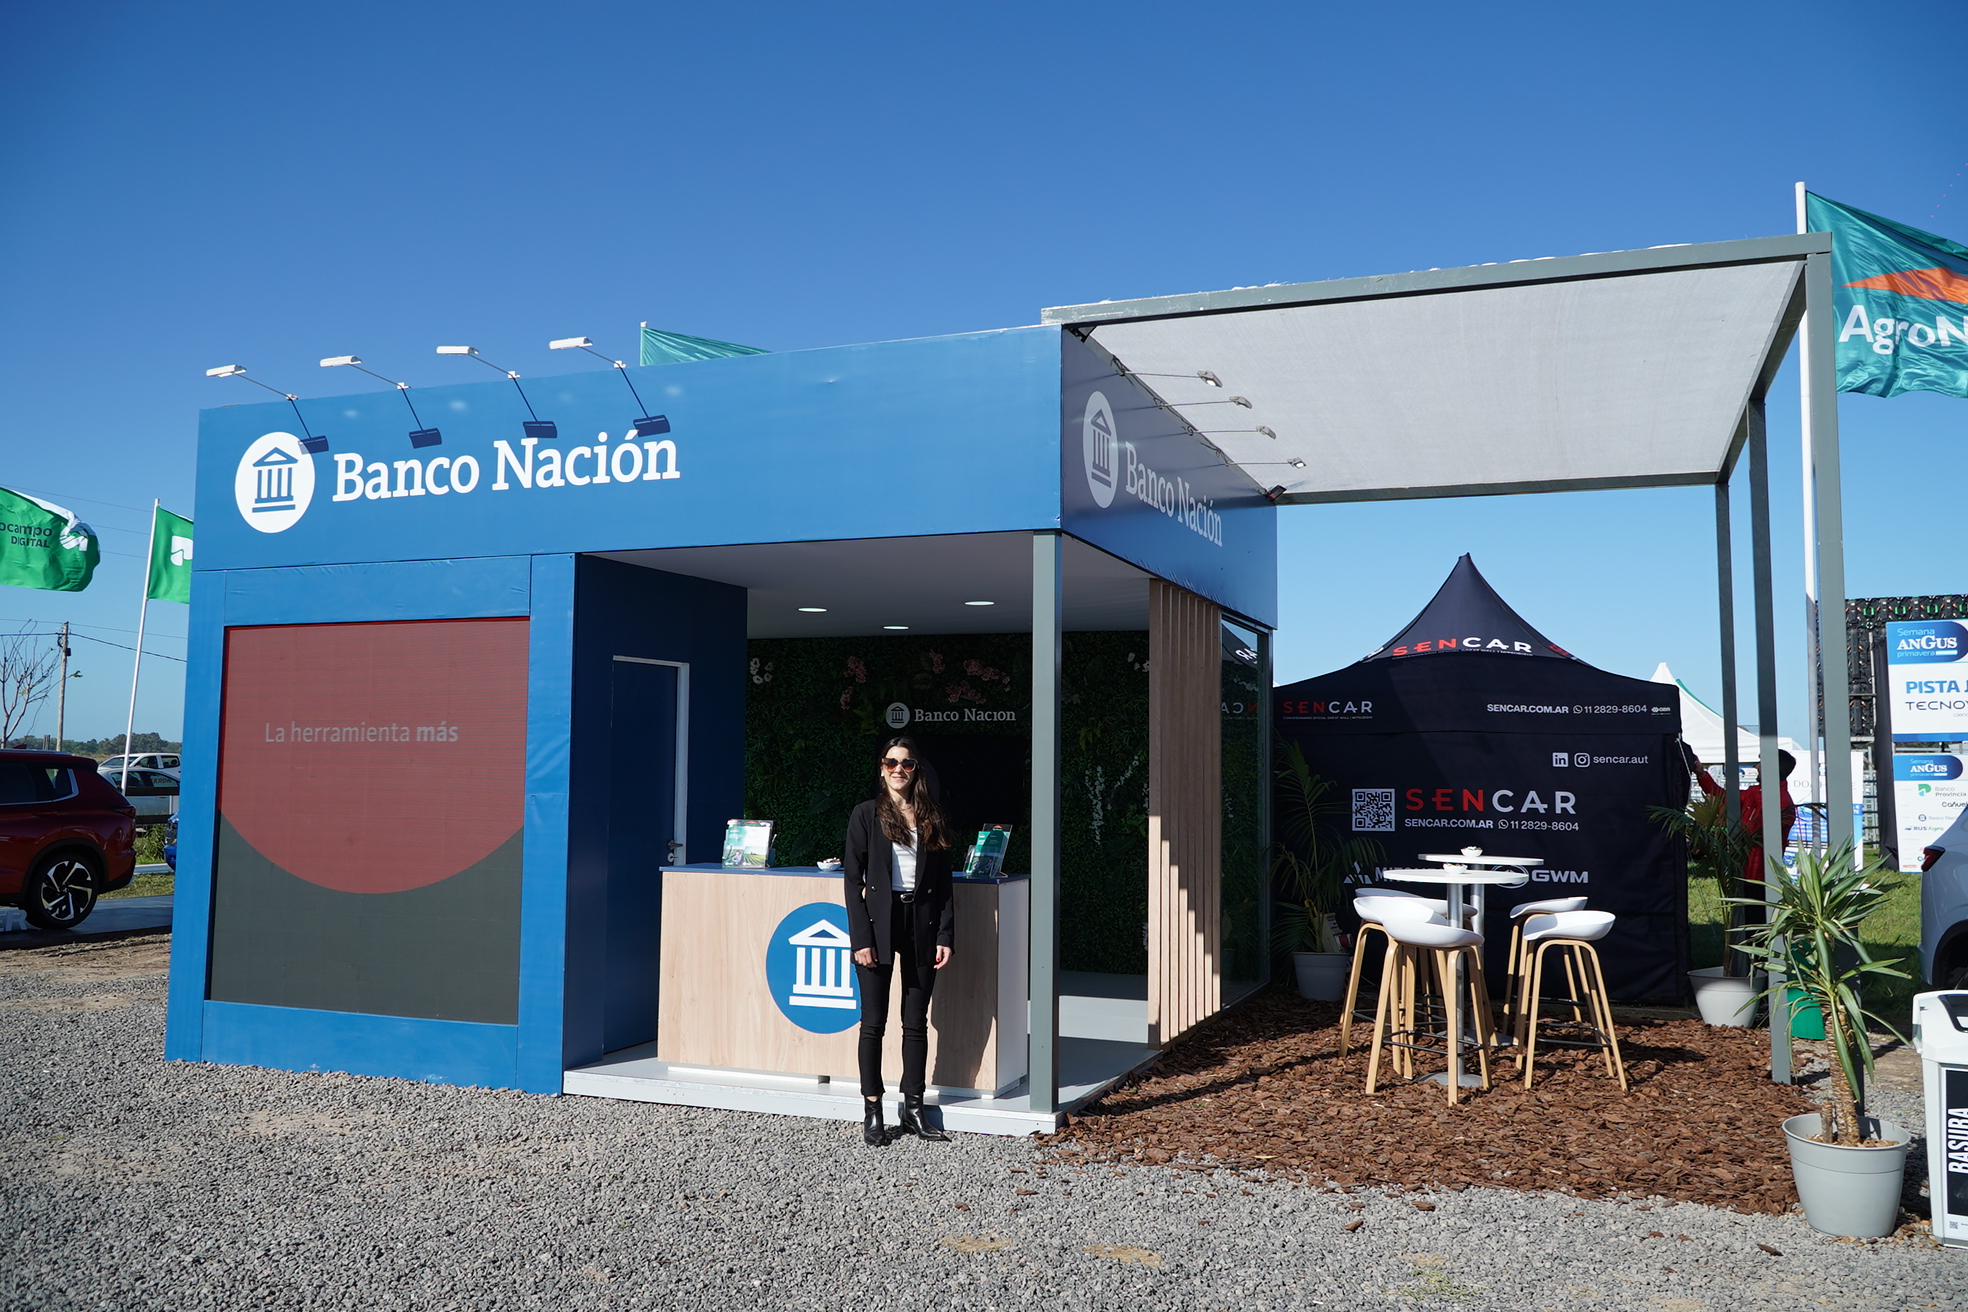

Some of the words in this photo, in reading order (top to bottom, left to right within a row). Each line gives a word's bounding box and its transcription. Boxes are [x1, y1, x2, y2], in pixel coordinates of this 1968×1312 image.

[332, 452, 480, 502] Banco
[492, 429, 681, 491] Nación
[1125, 441, 1175, 518] Banco
[1177, 476, 1223, 547] Nación
[11, 535, 50, 548] DIGITAL
[1897, 628, 1935, 637] Semana
[1392, 637, 1532, 657] SENCAR
[1897, 649, 1935, 658] primavera
[1905, 680, 1961, 694] PISTA
[1283, 701, 1373, 713] SENCAR
[1487, 704, 1569, 714] SENCAR.COM.AR
[1593, 704, 1647, 714] 2829-8604
[914, 708, 959, 722] Banco
[265, 722, 285, 742] La
[291, 721, 410, 742] herramienta
[416, 721, 458, 742] más
[1593, 755, 1649, 764] sencar.aut
[1405, 788, 1577, 814] SENCAR
[1404, 818, 1494, 829] SENCAR.COM.AR
[1520, 820, 1580, 831] 2829-8604
[1531, 869, 1589, 884] GWM
